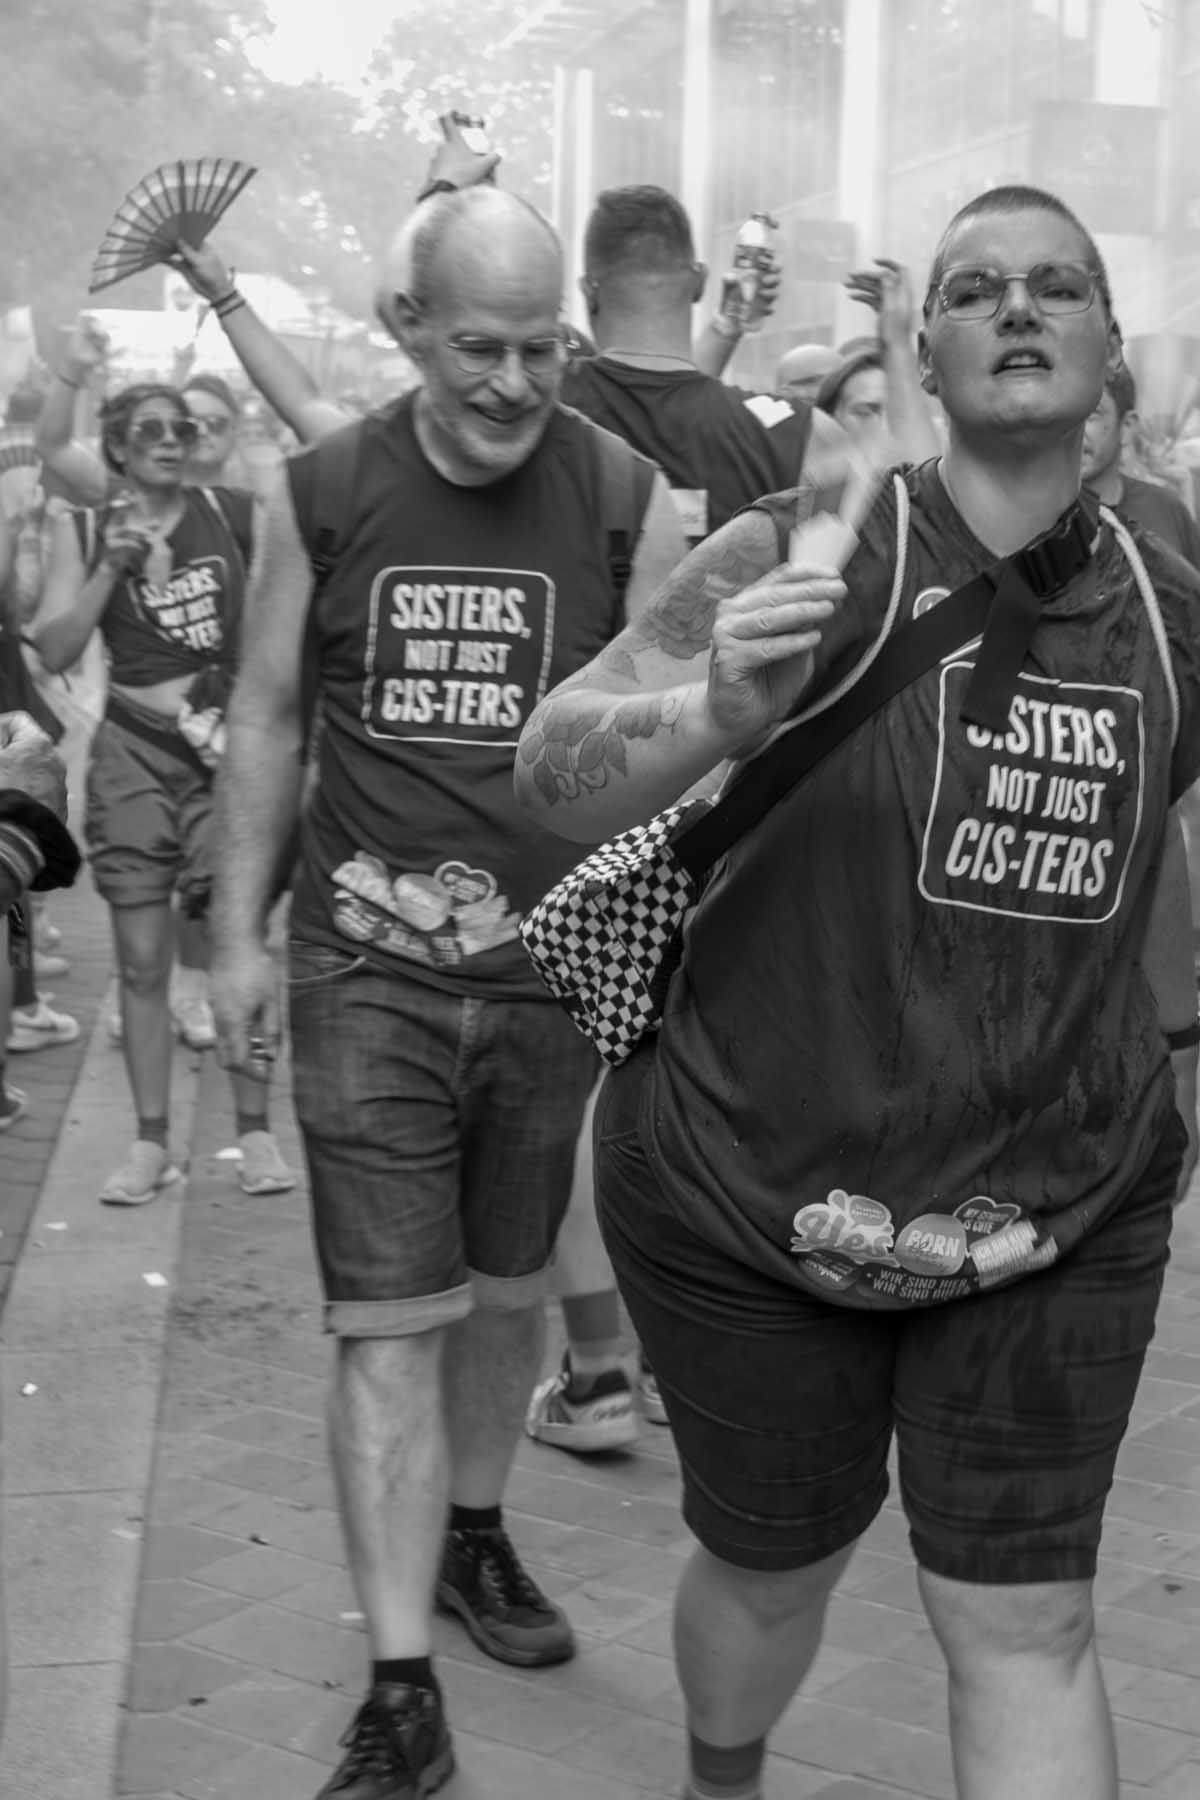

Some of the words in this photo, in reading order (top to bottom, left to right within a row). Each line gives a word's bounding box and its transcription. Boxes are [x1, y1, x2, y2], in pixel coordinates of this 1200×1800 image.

[390, 583, 532, 640] SISTERS,
[404, 638, 455, 671] NOT
[454, 640, 512, 675] JUST
[381, 678, 524, 729] CIS-TERS
[986, 764, 1042, 815] NOT
[1040, 775, 1107, 824] JUST
[945, 818, 1114, 897] CIS-TERS
[872, 1277, 897, 1295] WIR
[899, 1284, 930, 1301] SIND
[880, 1268, 903, 1286] WIR
[906, 1274, 937, 1291] SIND
